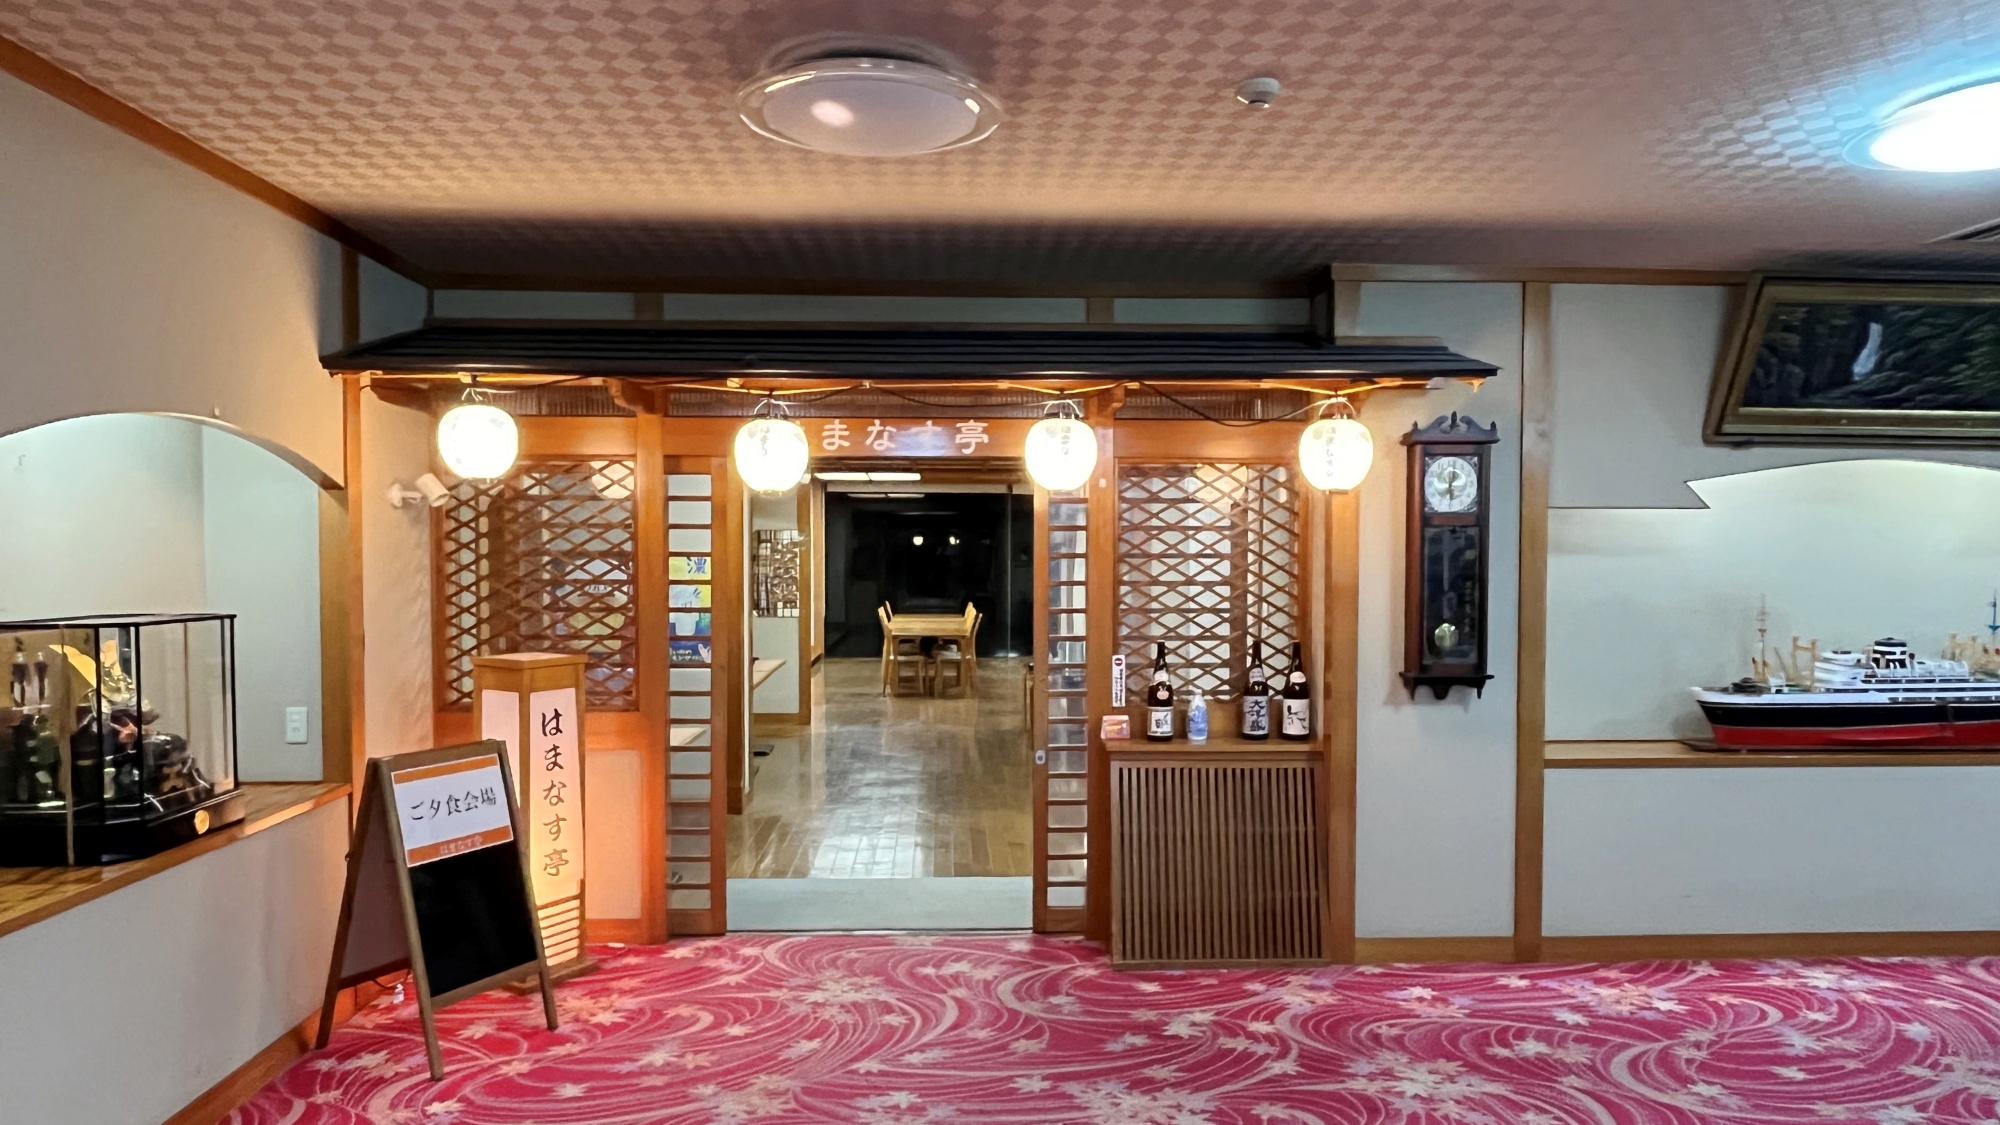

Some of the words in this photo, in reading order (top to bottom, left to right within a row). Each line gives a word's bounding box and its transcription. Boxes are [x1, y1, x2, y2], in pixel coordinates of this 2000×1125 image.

[795, 419, 989, 455] まなす亭
[410, 787, 497, 820] ご夕食会場
[541, 708, 570, 877] はまなす亭
